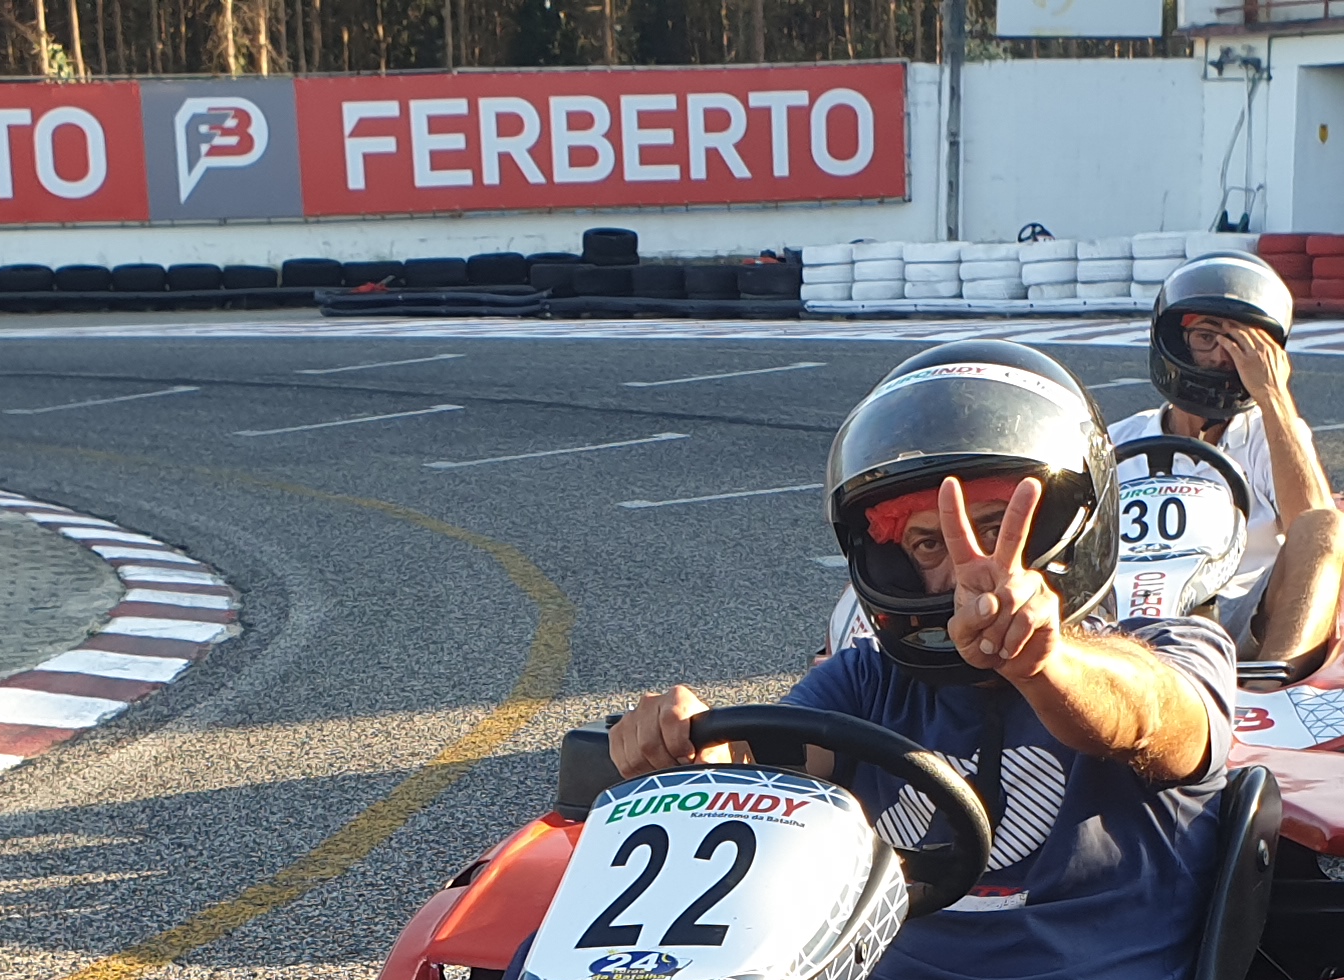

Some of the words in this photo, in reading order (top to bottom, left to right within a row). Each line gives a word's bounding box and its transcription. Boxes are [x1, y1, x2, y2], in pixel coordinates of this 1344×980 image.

[342, 87, 875, 190] FERBERTO
[1120, 486, 1205, 500] UROINDY
[1121, 497, 1187, 543] 30
[1129, 572, 1166, 617] BERTO
[605, 791, 811, 824] EUROINDY
[766, 816, 806, 828] Batalha
[574, 819, 757, 949] 22
[600, 953, 661, 972] 24
